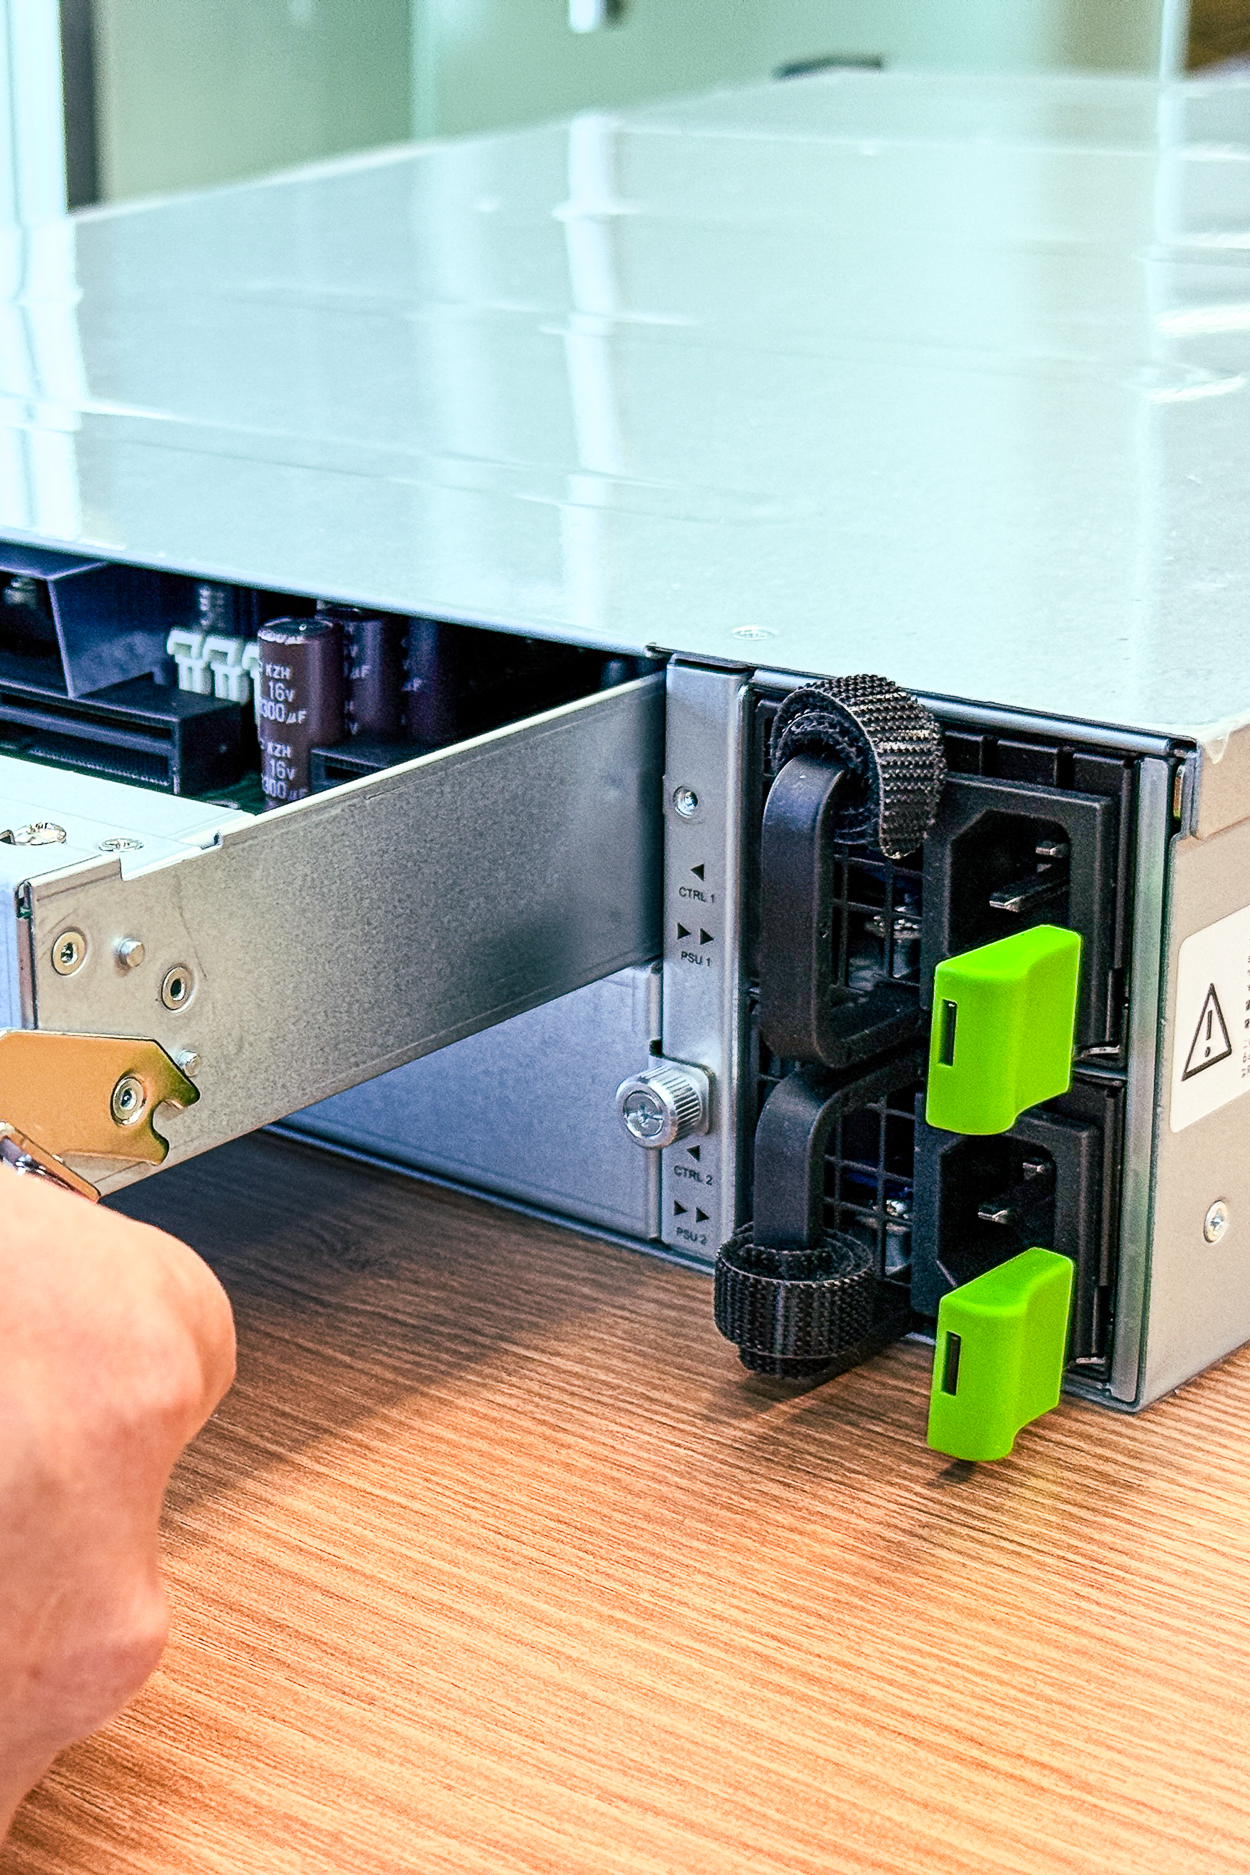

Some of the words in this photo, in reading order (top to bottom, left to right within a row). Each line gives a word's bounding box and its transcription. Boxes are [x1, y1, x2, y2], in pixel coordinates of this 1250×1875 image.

[265, 662, 291, 680] KZH
[267, 741, 292, 758] KZH
[678, 886, 707, 903] CTRL
[710, 894, 716, 904] 1
[681, 950, 703, 965] PSU
[706, 957, 711, 967] 1
[673, 1164, 703, 1183] CTRL
[705, 1174, 714, 1186] 2
[675, 1226, 699, 1243] PSU
[699, 1233, 708, 1246] 2
